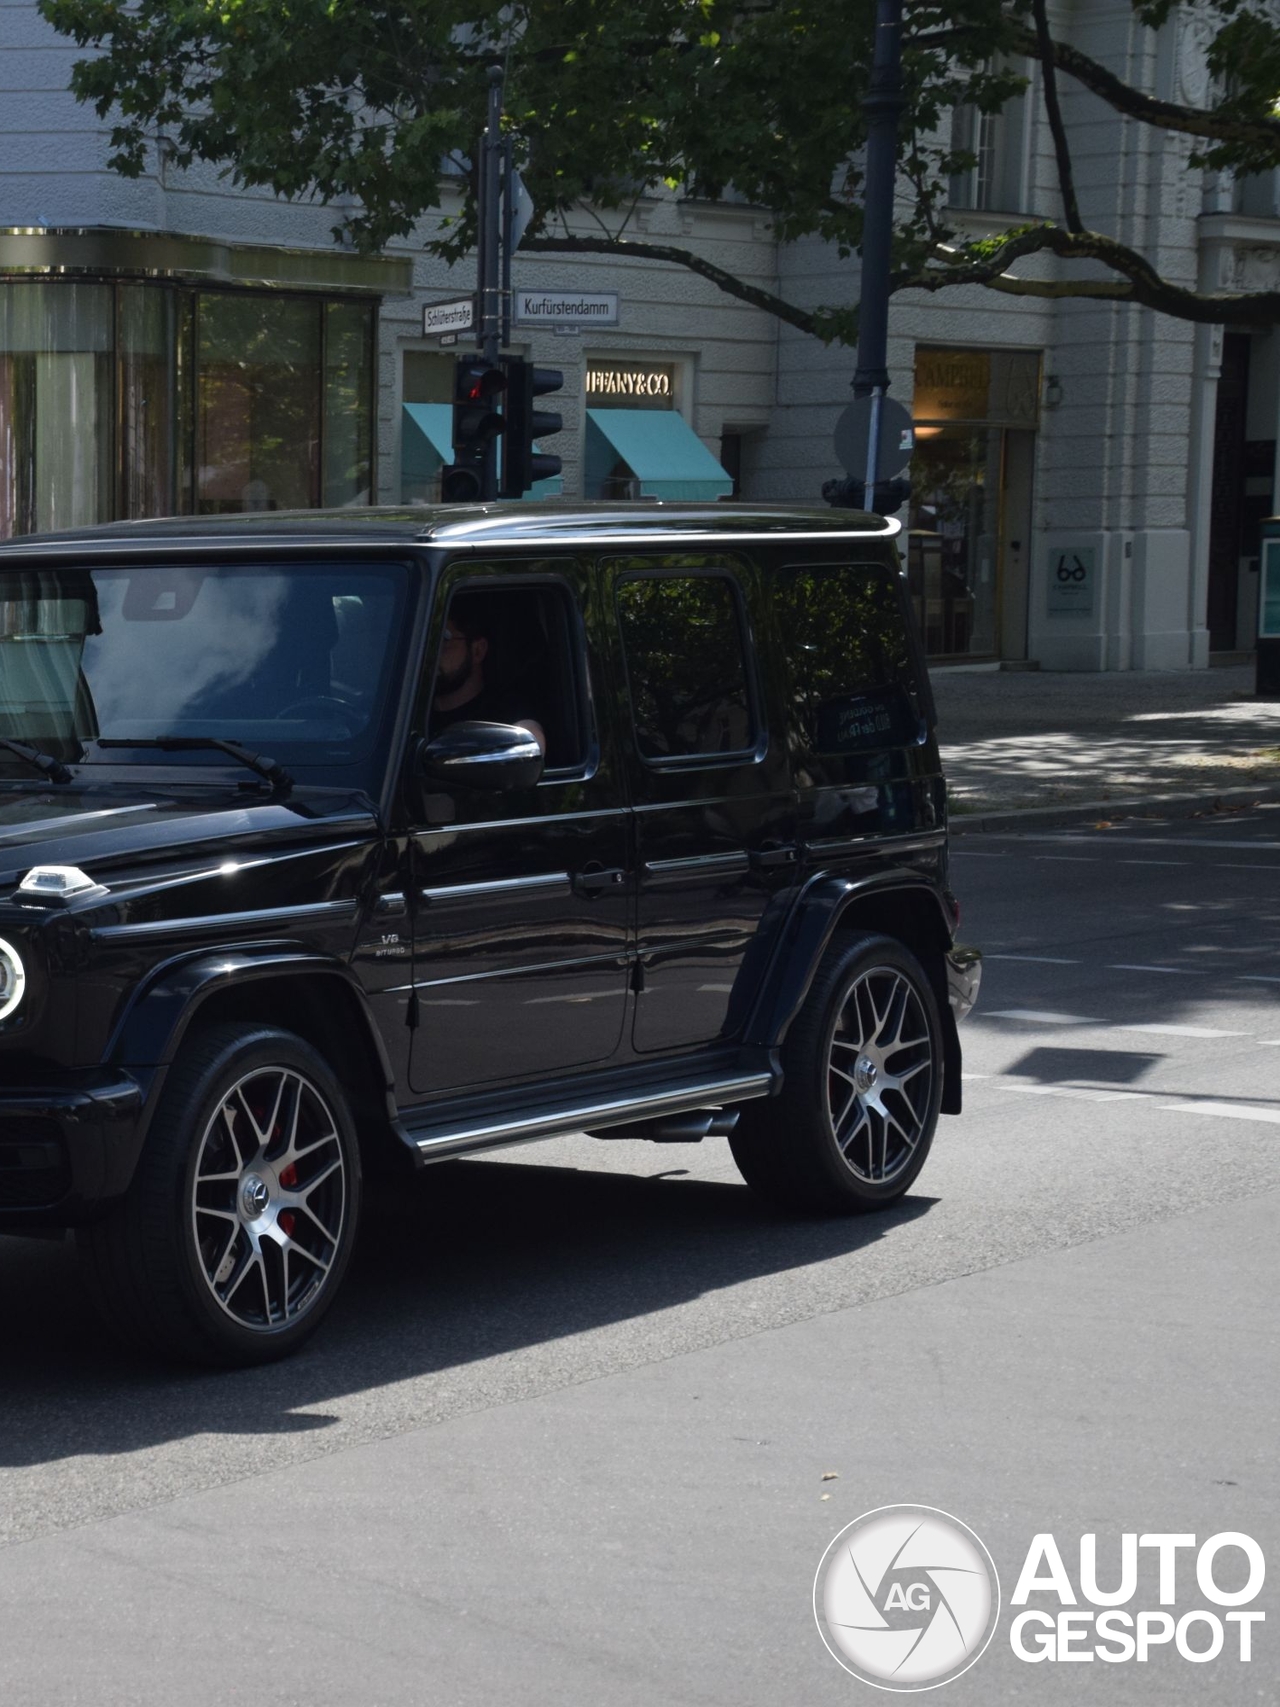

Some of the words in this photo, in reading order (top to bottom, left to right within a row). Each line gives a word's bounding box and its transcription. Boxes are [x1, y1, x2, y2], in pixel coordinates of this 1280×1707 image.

[524, 298, 609, 315] Kurfürstendamm
[427, 305, 471, 327] Schlüterstraße
[381, 934, 399, 944] V8
